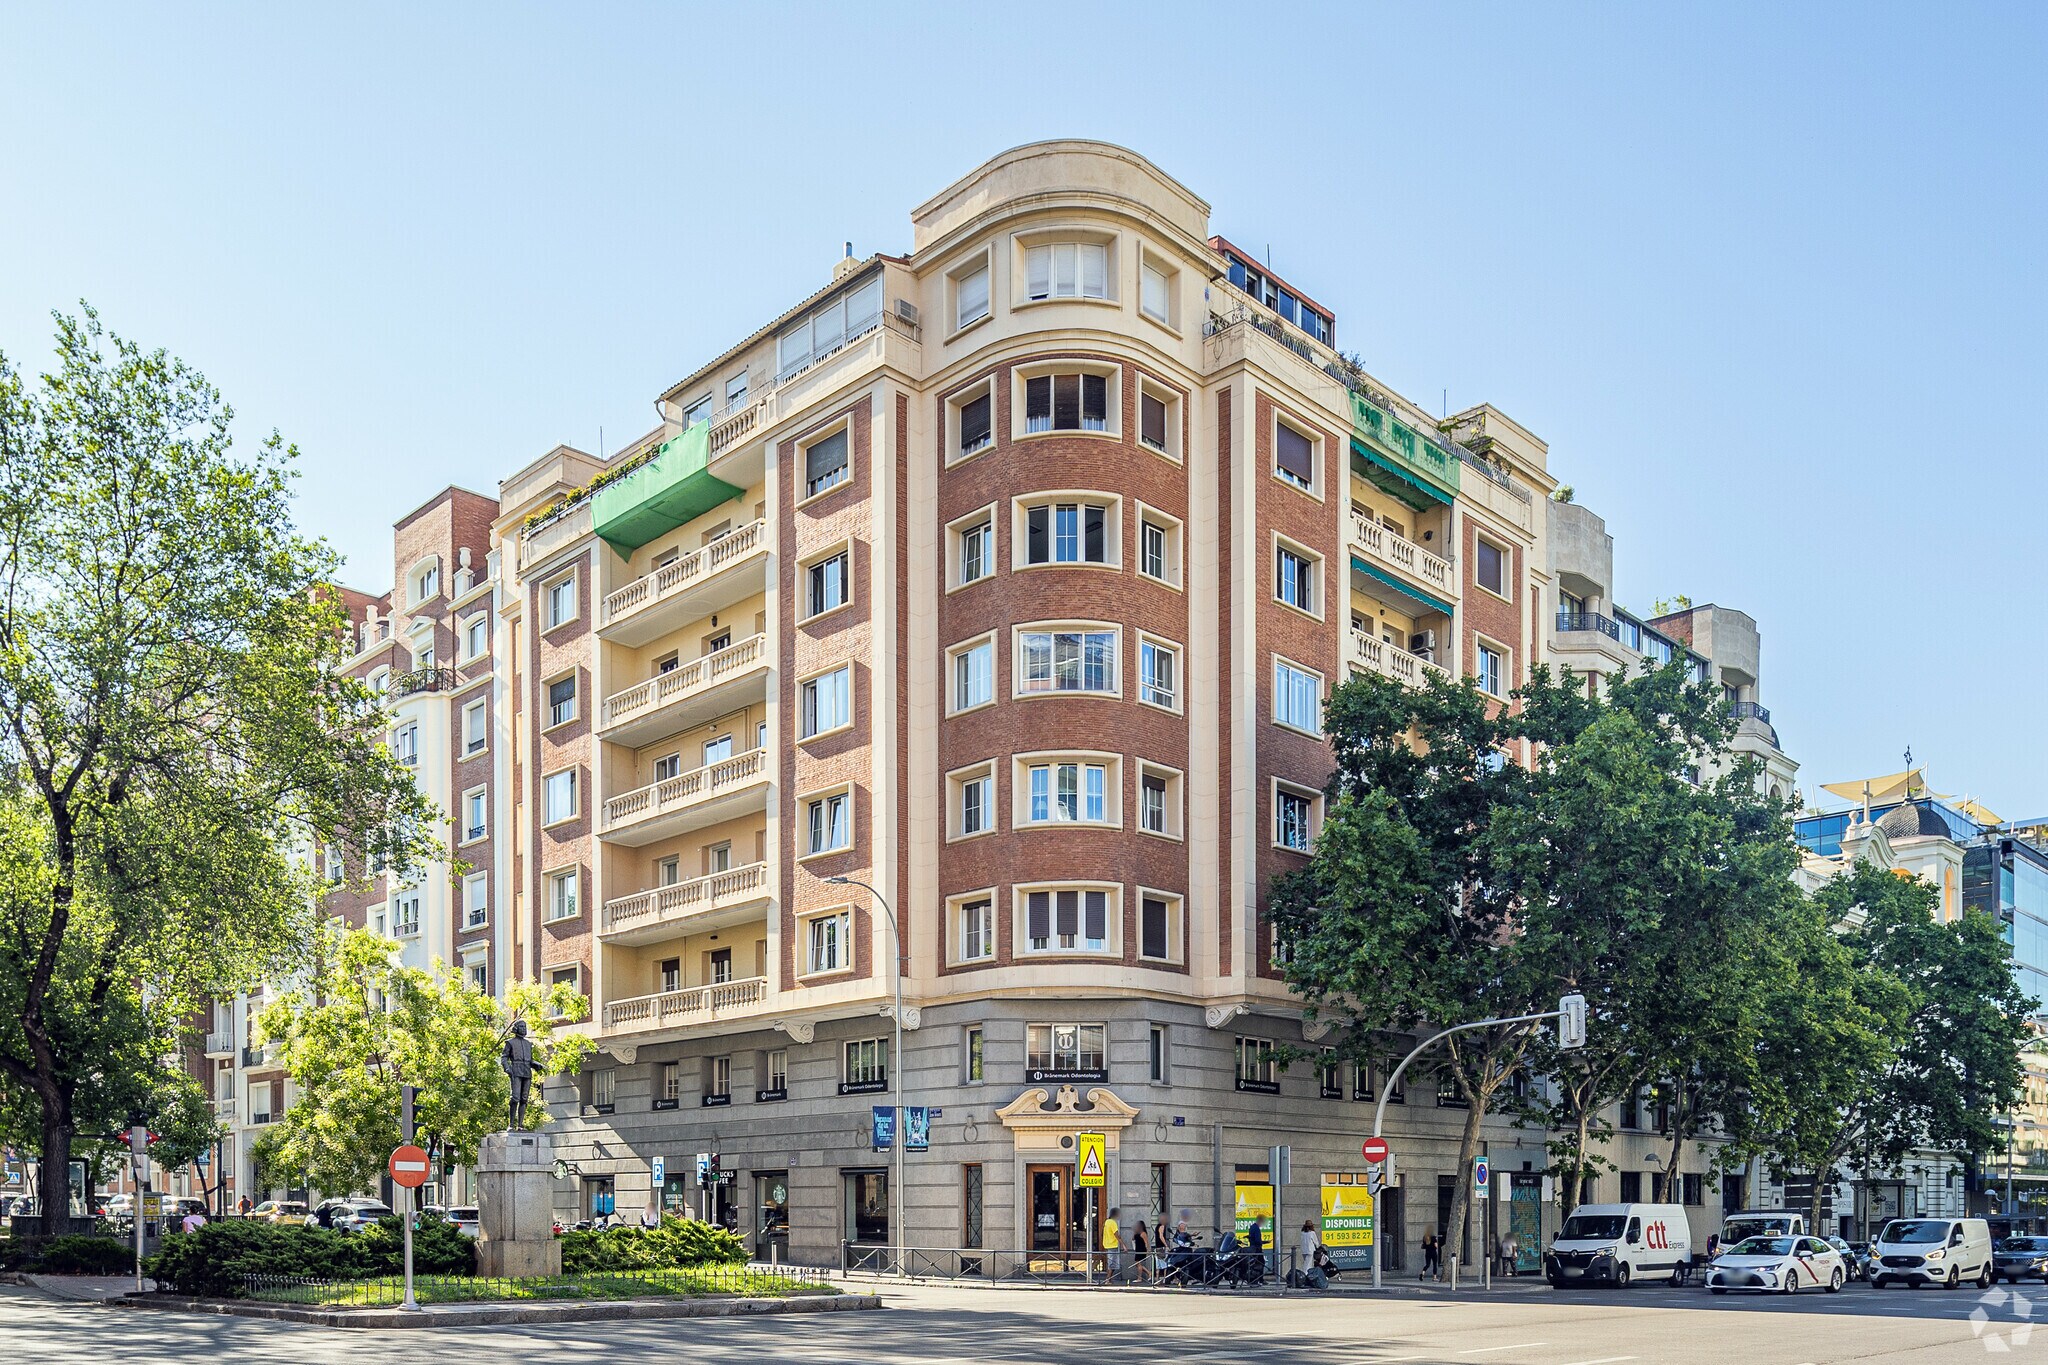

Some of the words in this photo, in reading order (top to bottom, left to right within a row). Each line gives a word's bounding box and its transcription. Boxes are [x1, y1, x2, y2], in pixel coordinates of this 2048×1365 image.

[655, 1166, 662, 1180] P
[1325, 1219, 1372, 1228] DISPONIBLE
[1647, 1220, 1668, 1249] ctt
[1669, 1241, 1685, 1249] Express
[1330, 1250, 1348, 1258] LASSEN
